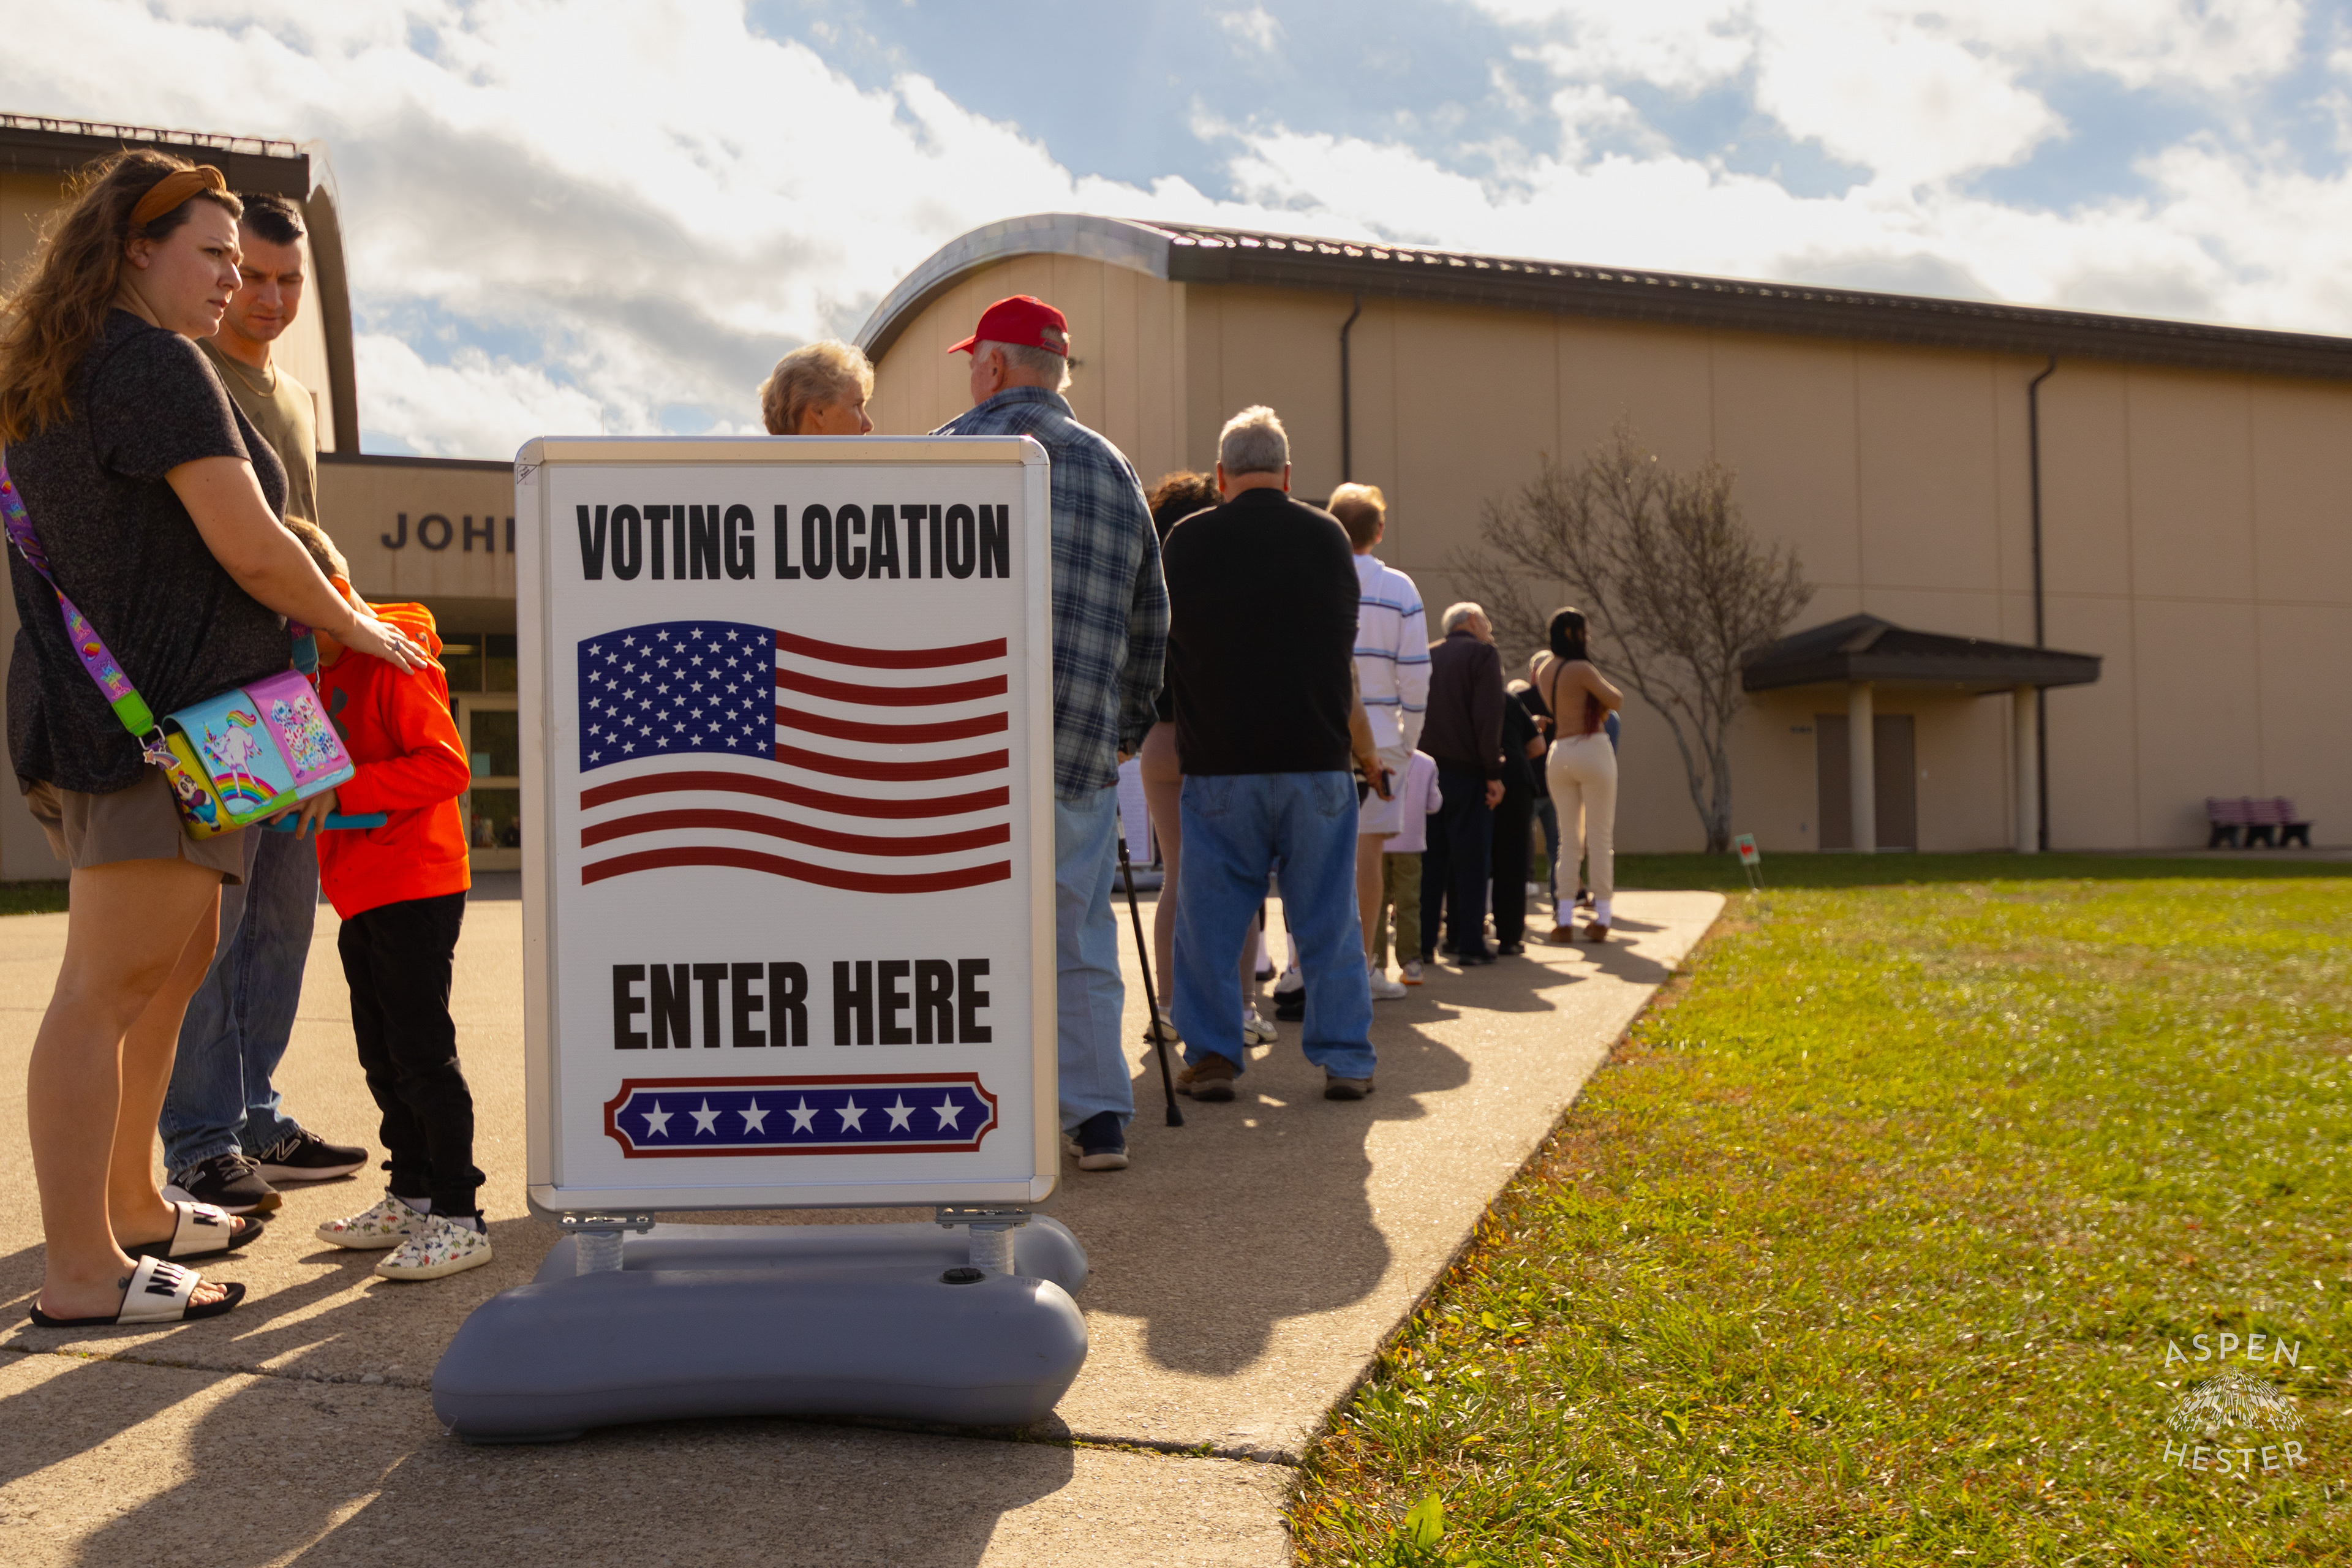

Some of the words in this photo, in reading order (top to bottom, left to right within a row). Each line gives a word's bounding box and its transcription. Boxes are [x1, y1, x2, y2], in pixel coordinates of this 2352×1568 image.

[576, 503, 755, 581] VOTING
[774, 503, 1010, 580] LOCATION
[613, 961, 809, 1050] ENTER
[833, 958, 992, 1046] HERE
